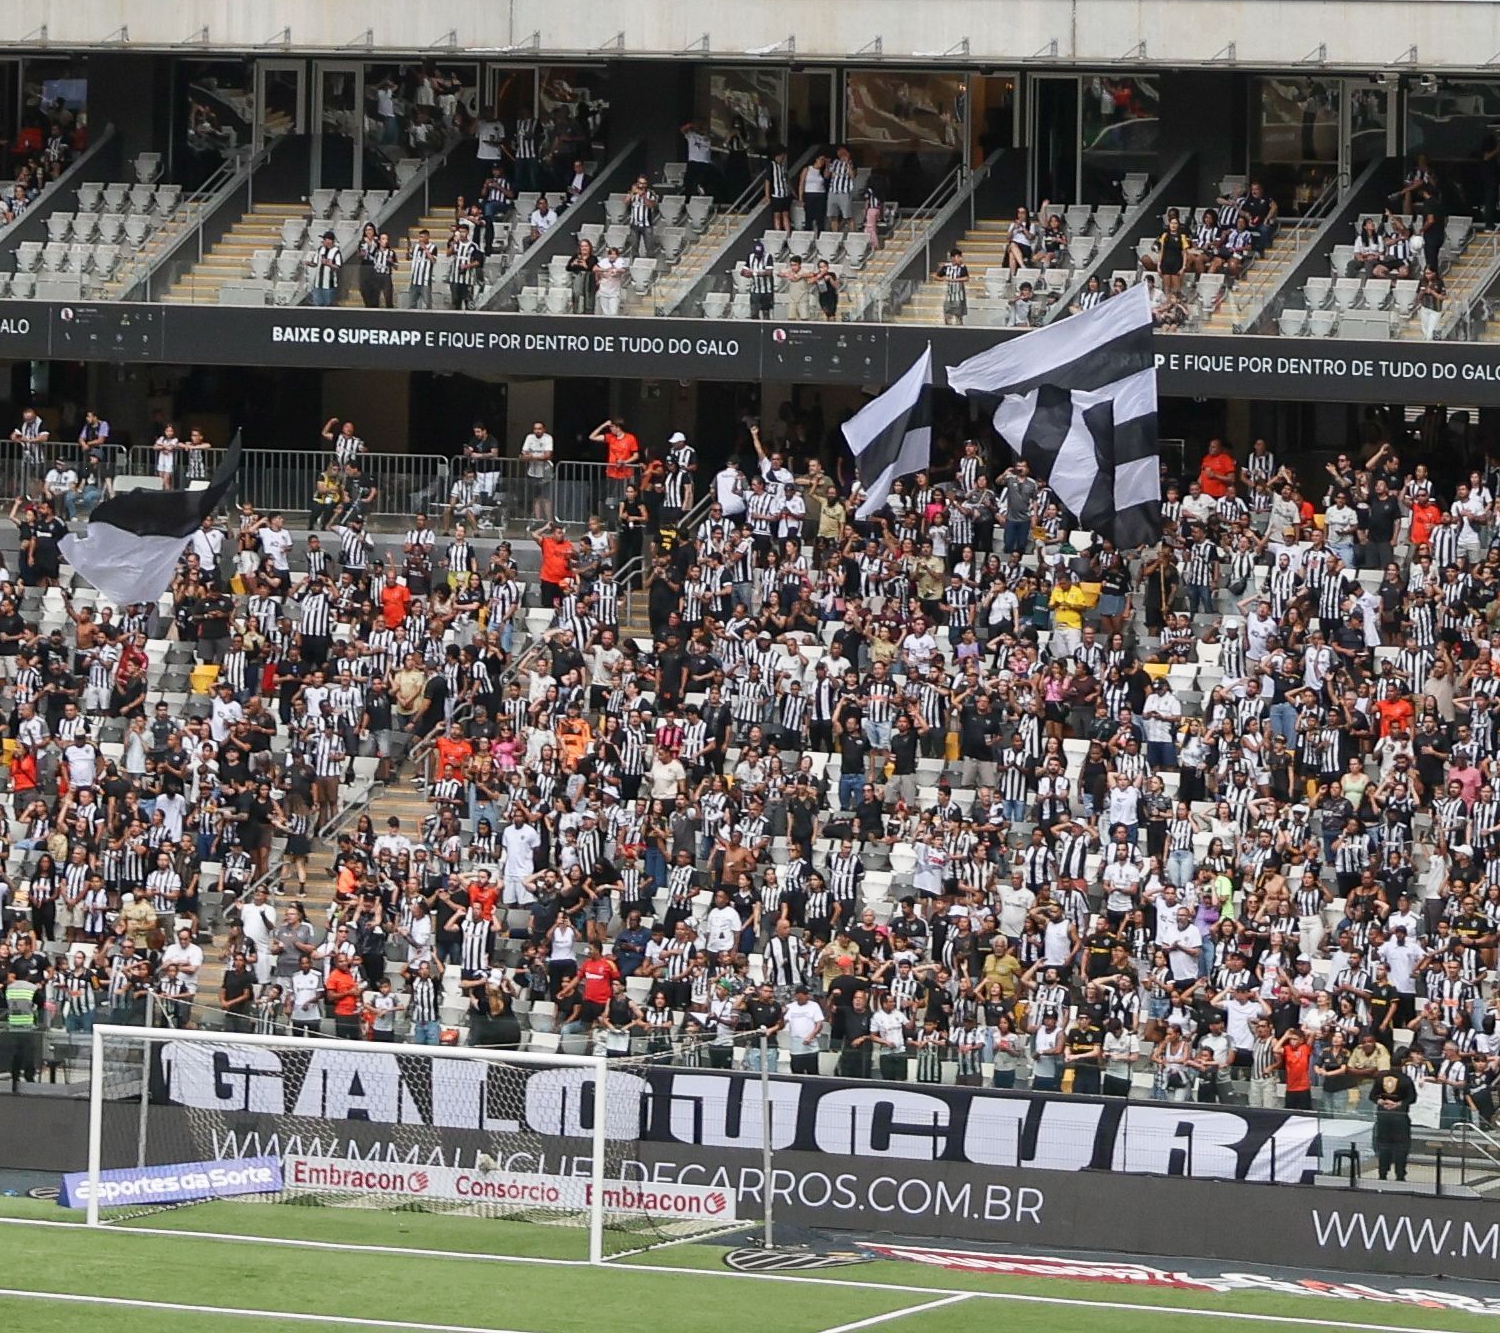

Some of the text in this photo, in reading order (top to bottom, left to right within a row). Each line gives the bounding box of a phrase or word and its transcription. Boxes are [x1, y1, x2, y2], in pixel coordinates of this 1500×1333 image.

[272, 326, 739, 356] BAIXE O SUPERAPP E FIQUE POR DENTRO DE TUDO DO GALO
[1168, 354, 1180, 371] E
[1184, 354, 1234, 373] FIQUE
[1238, 356, 1273, 374] POR
[1277, 357, 1347, 376] DENTRO
[1351, 359, 1374, 377] DE
[1378, 360, 1428, 379] TUDO
[1432, 362, 1458, 380] DO
[161, 1039, 1376, 1184] GALOUCURA
[209, 1165, 274, 1188] Sorte
[294, 1161, 701, 1214] Embracon Consórcio Embracon
